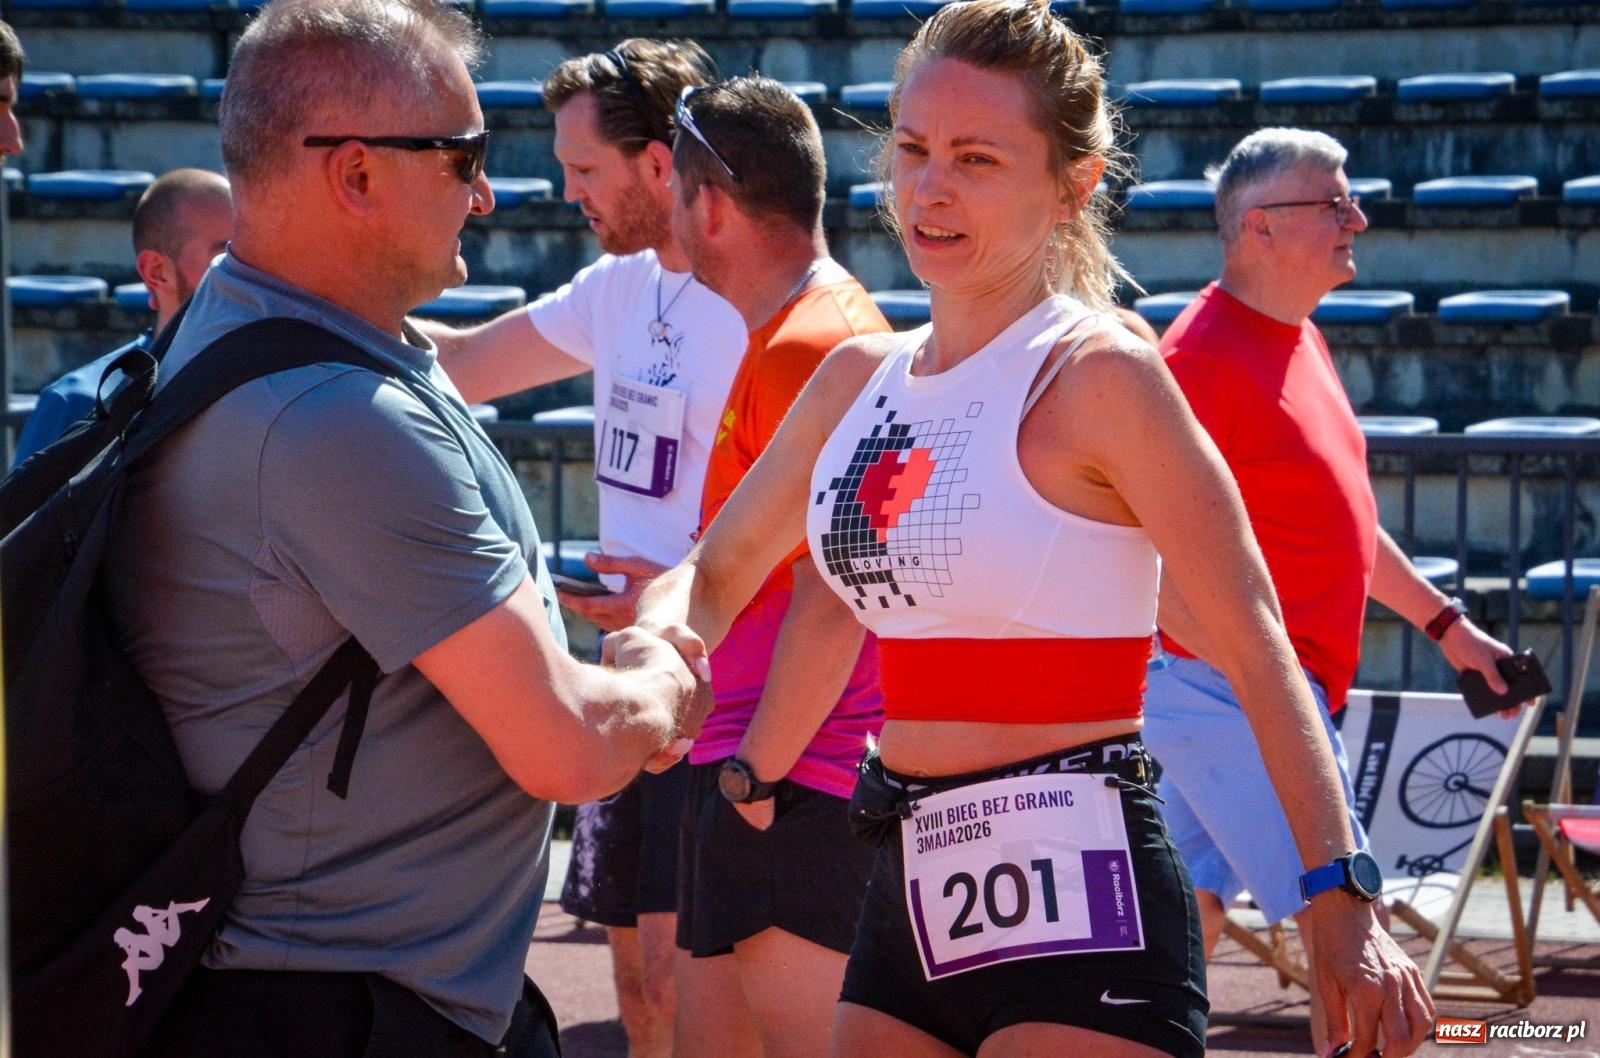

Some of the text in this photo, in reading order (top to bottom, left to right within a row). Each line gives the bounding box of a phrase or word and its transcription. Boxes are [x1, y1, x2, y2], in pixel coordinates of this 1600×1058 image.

[610, 427, 639, 472] 117
[853, 556, 920, 571] LOVING
[914, 790, 1074, 835] XVIII BIEG BEZ GRANIC
[917, 820, 992, 855] 3MAJA2026
[942, 858, 1060, 941] 201
[1112, 873, 1125, 917] Racibórz
